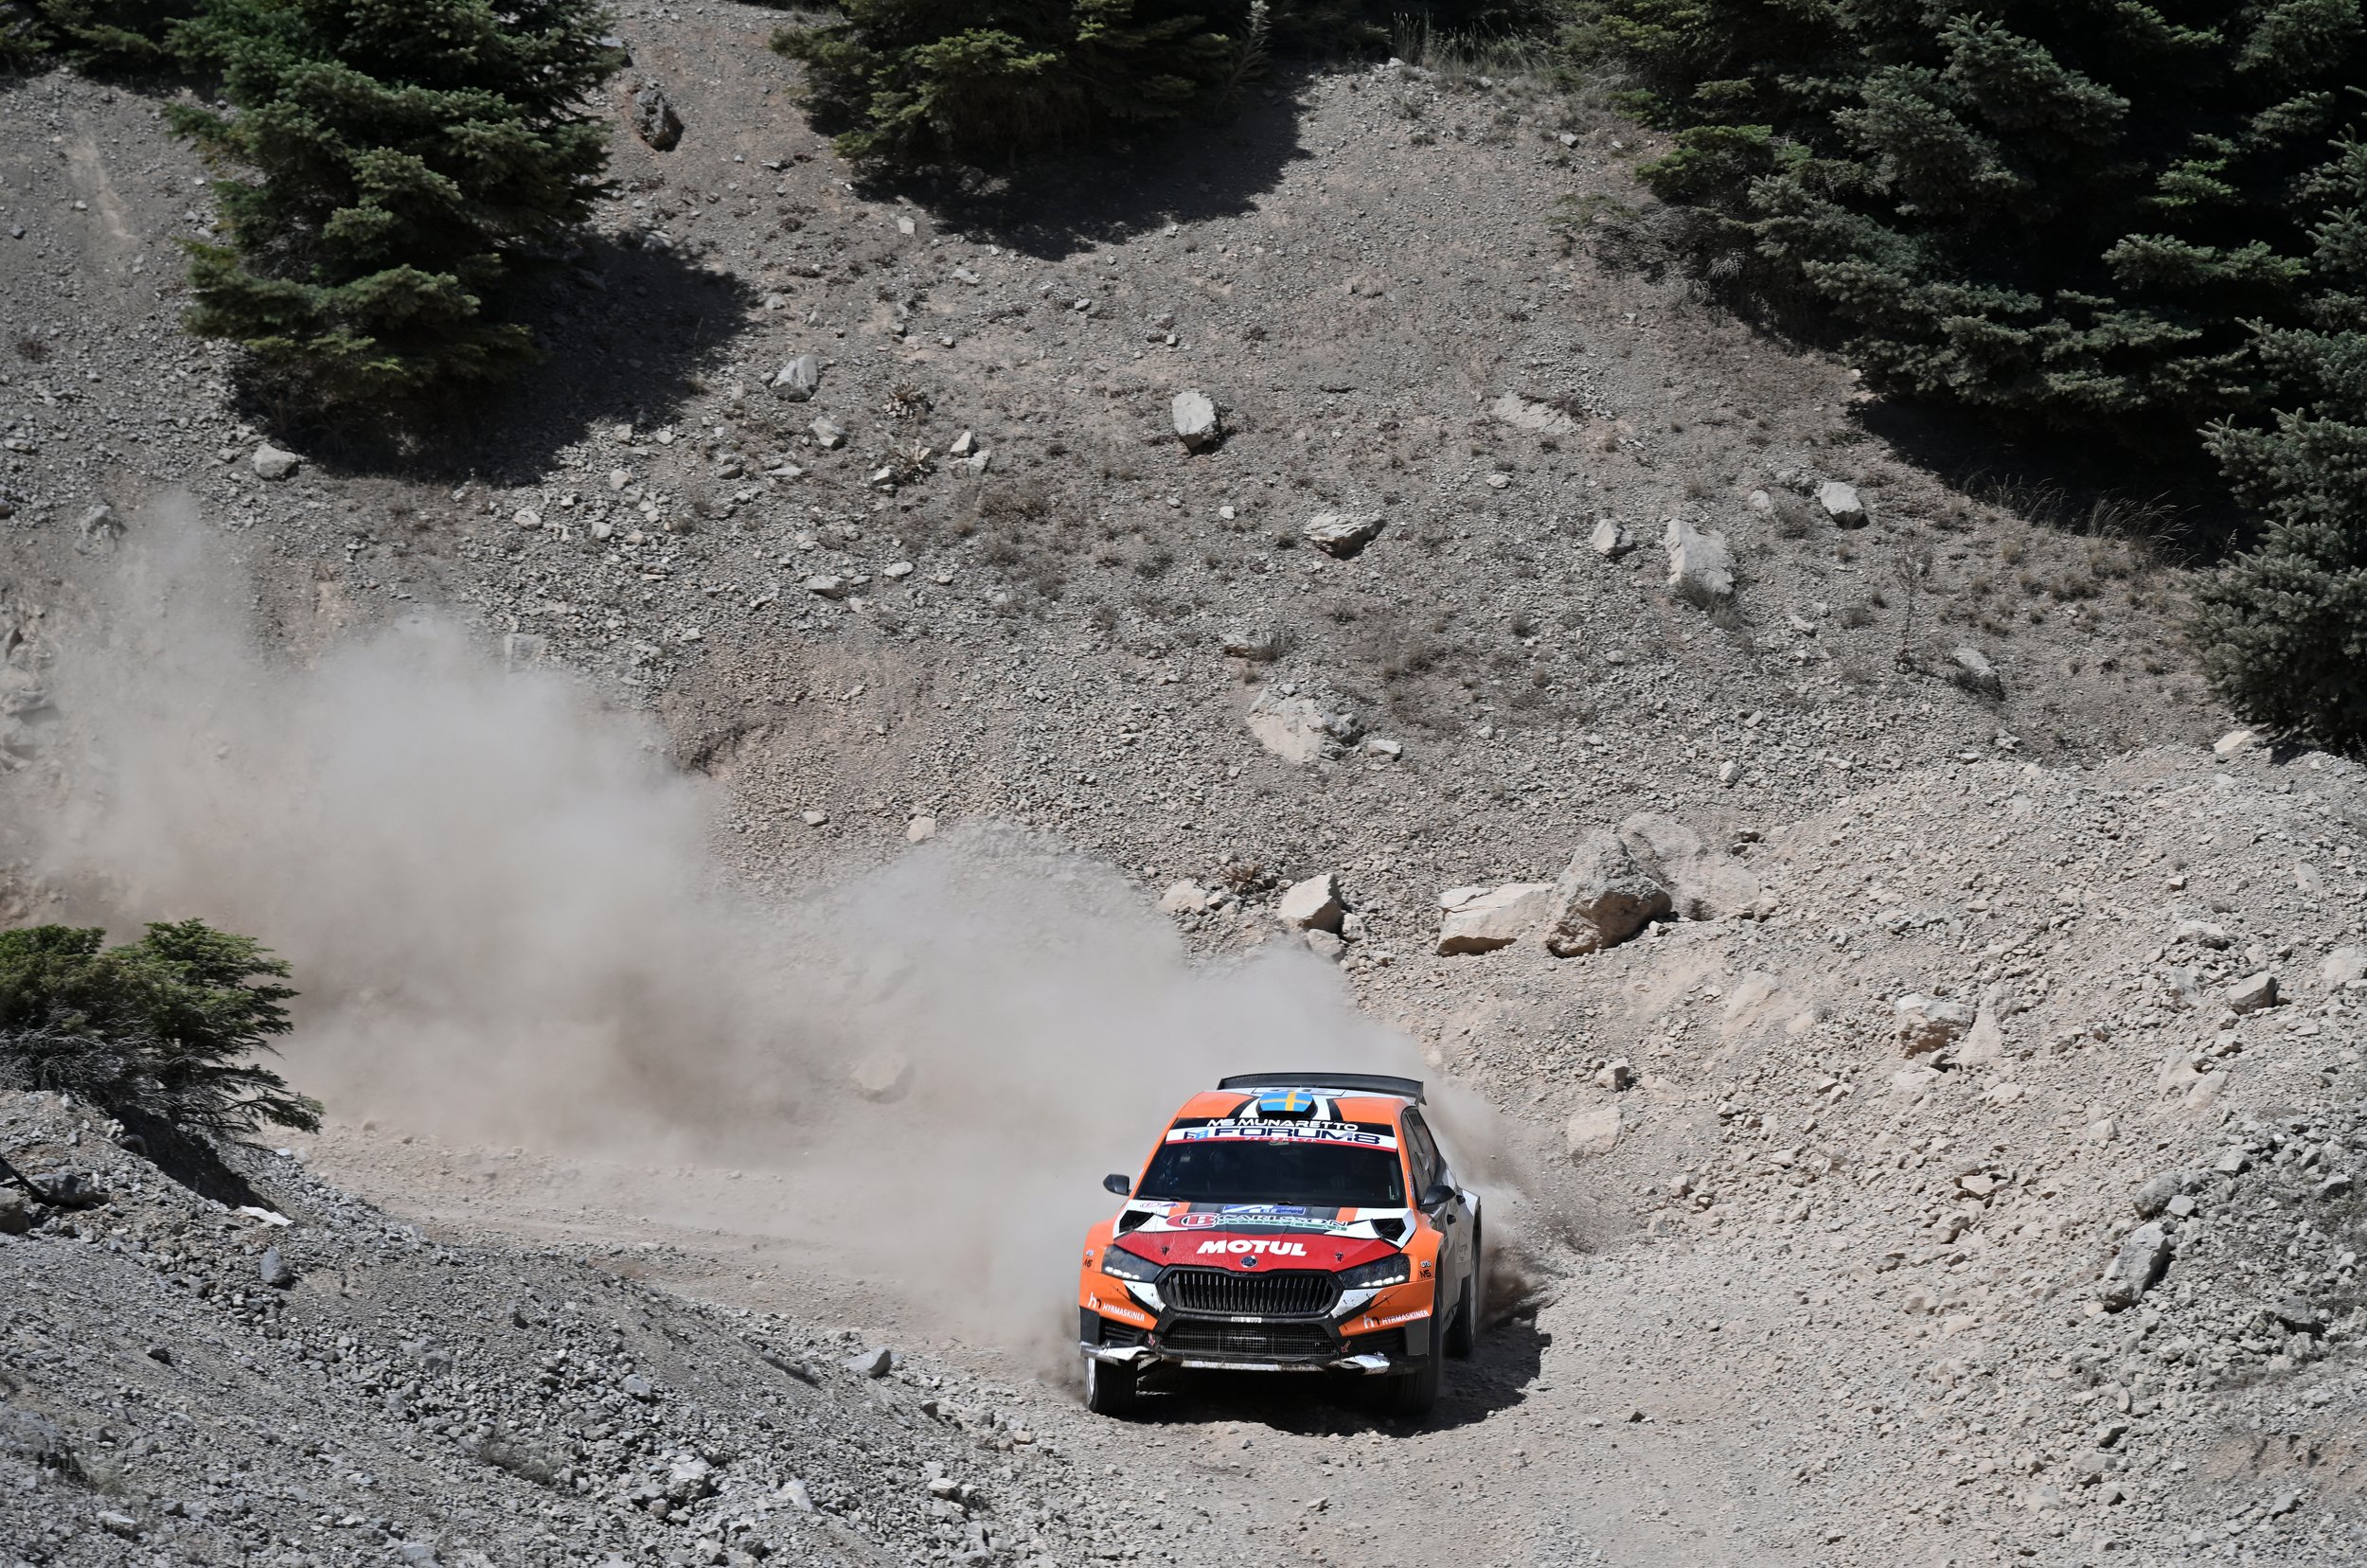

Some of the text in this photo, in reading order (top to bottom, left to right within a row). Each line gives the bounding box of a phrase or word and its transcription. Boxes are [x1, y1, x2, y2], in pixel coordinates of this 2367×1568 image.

[1237, 1118, 1359, 1131] MUNARETTO
[1215, 1128, 1380, 1145] FORUM8
[1196, 1239, 1307, 1256] MOTUL
[1102, 1303, 1145, 1322] HYRMASKINER
[1381, 1310, 1429, 1326] HYRMASKINER
